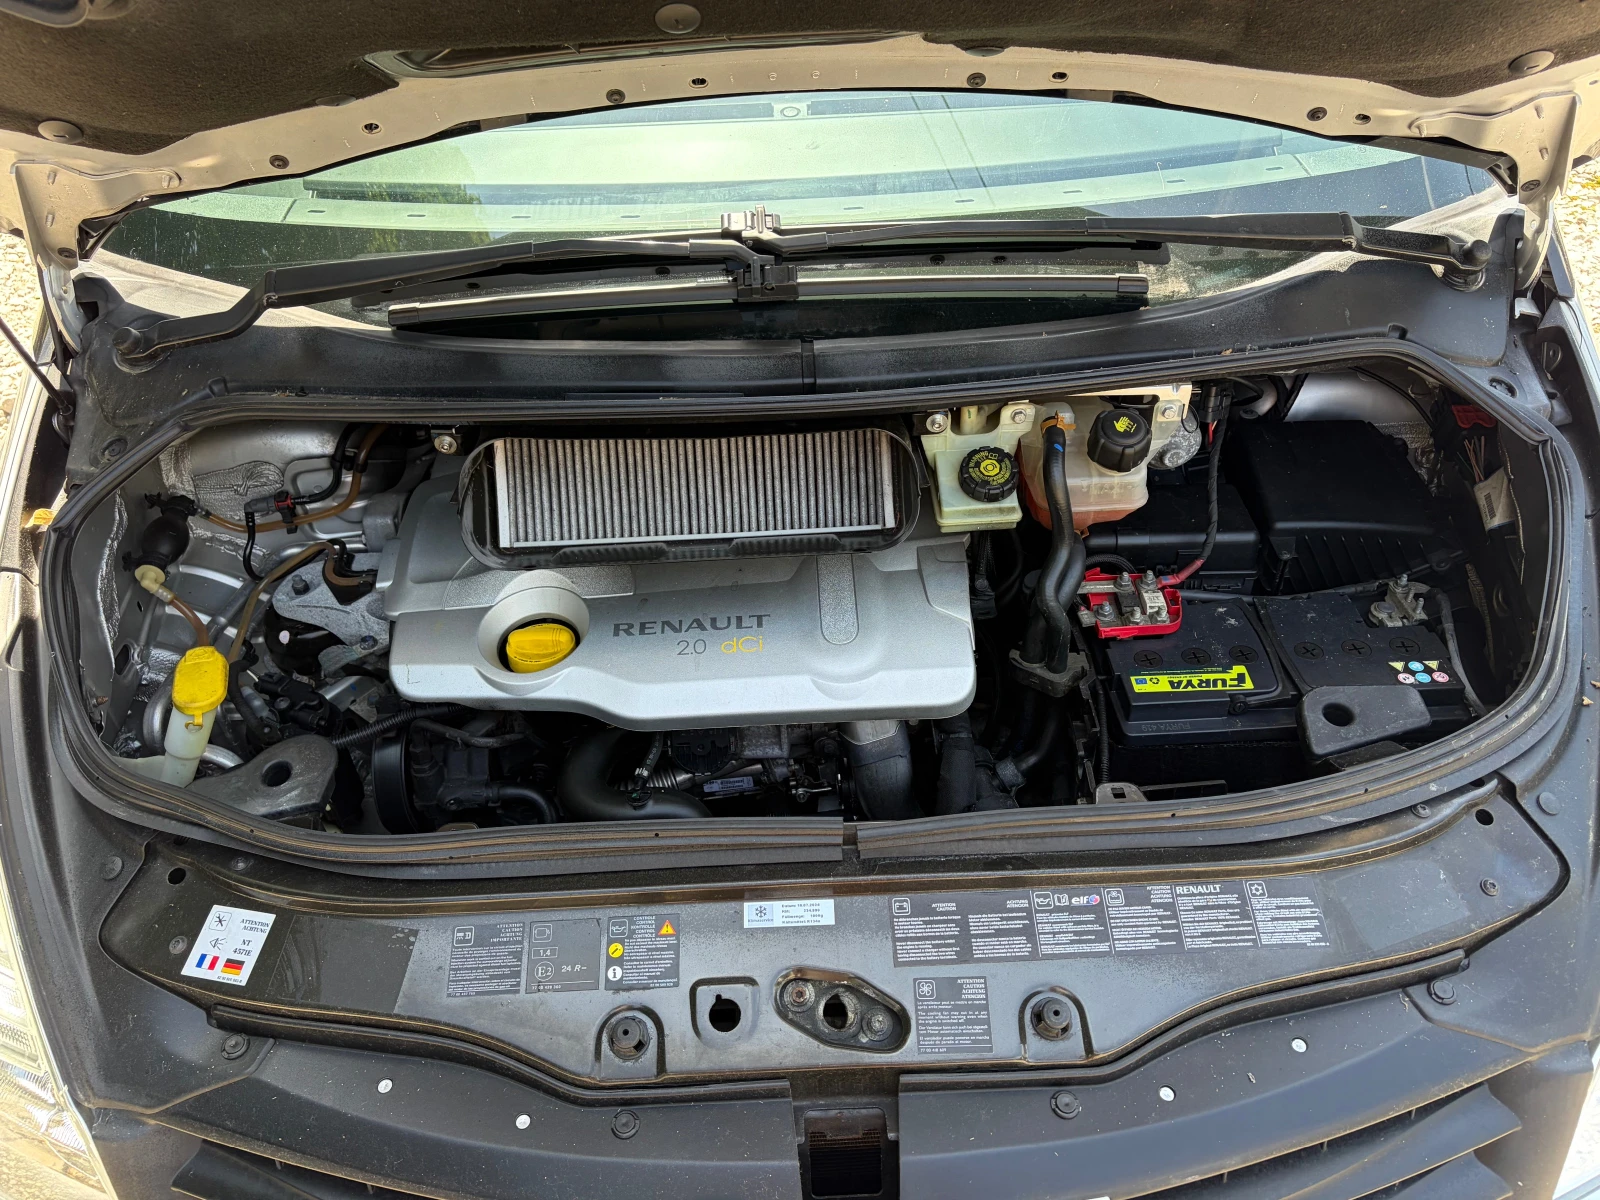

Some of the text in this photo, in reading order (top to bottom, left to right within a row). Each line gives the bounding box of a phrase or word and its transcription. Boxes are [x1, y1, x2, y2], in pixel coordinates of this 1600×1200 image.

[613, 614, 770, 637] RENAULT
[676, 636, 763, 655] 2.0 dCi
[1168, 673, 1246, 690] FURYA
[1176, 885, 1222, 894] RENAULT
[1072, 896, 1089, 904] elf
[232, 948, 252, 956] 4571E
